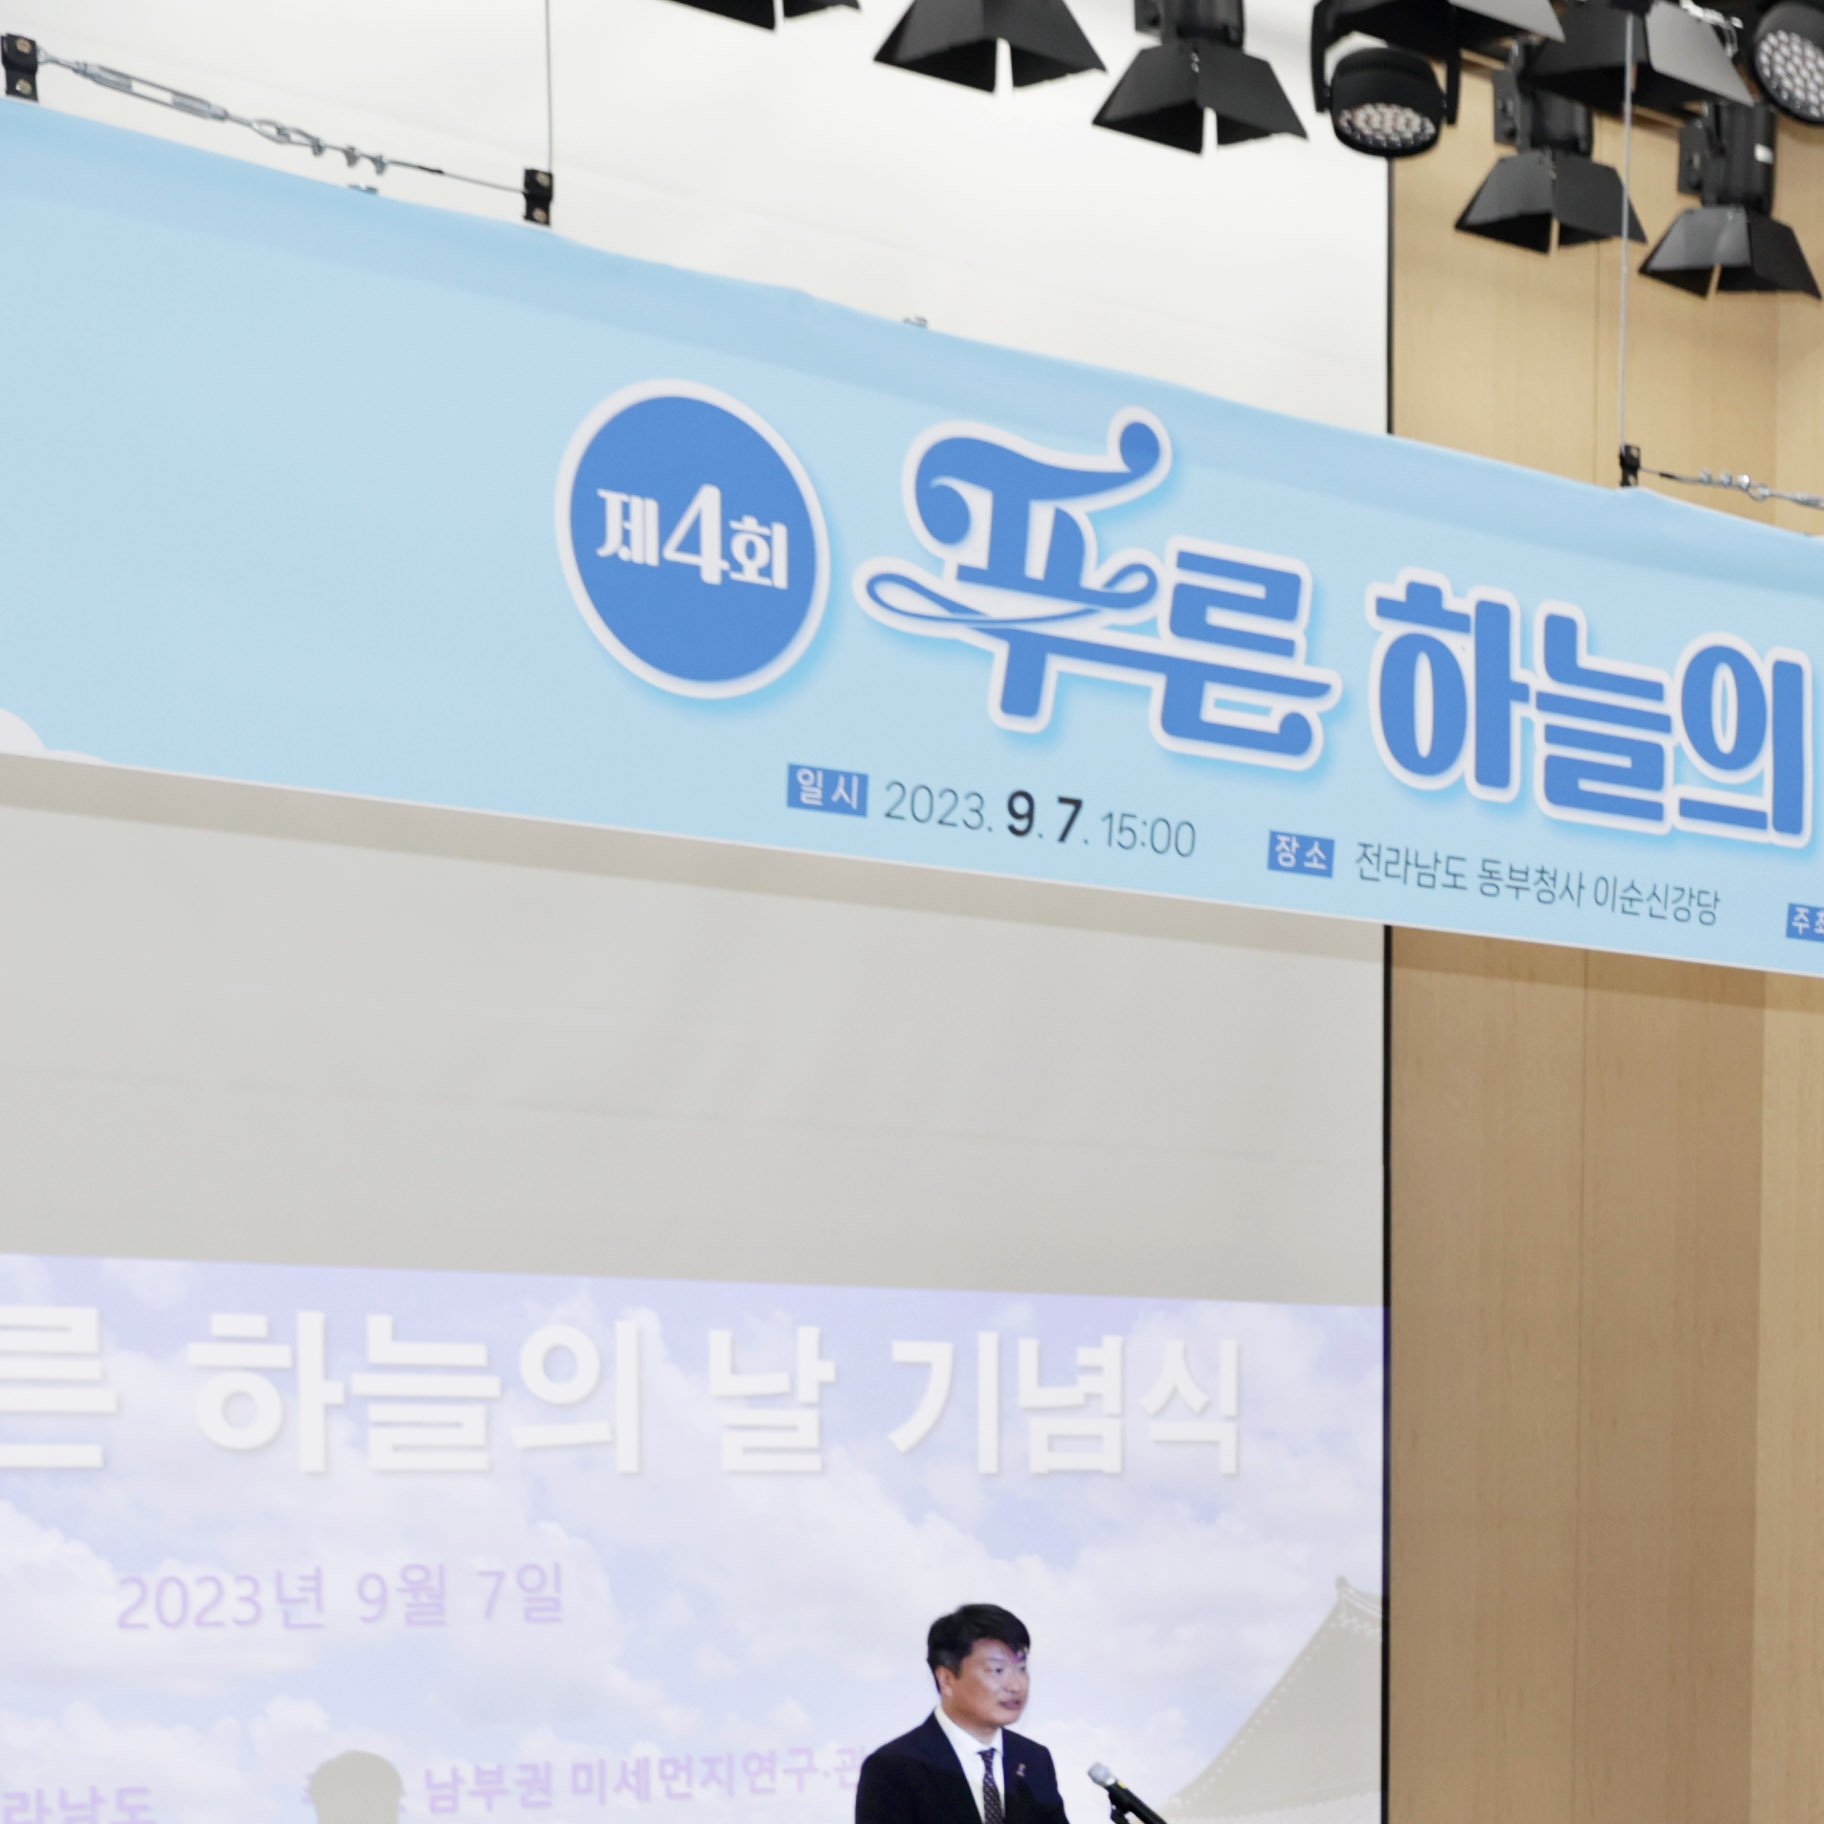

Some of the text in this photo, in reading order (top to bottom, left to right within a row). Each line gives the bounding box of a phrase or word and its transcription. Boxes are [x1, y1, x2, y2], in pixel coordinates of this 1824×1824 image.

[596, 484, 790, 590] 제4회
[864, 420, 1334, 760] 푸른
[1374, 579, 1806, 838] 하늘의
[796, 767, 859, 811] 일시
[1101, 810, 1197, 859] 15:00
[1273, 835, 1722, 928] 장소 전라남도 동부청사 이순신강당
[186, 1309, 642, 1475] 하늘의
[707, 1324, 837, 1475] 날
[886, 1330, 1240, 1476] 기념식
[116, 1561, 564, 1632] 2023년 9월 7일
[424, 1760, 555, 1816] 남부권
